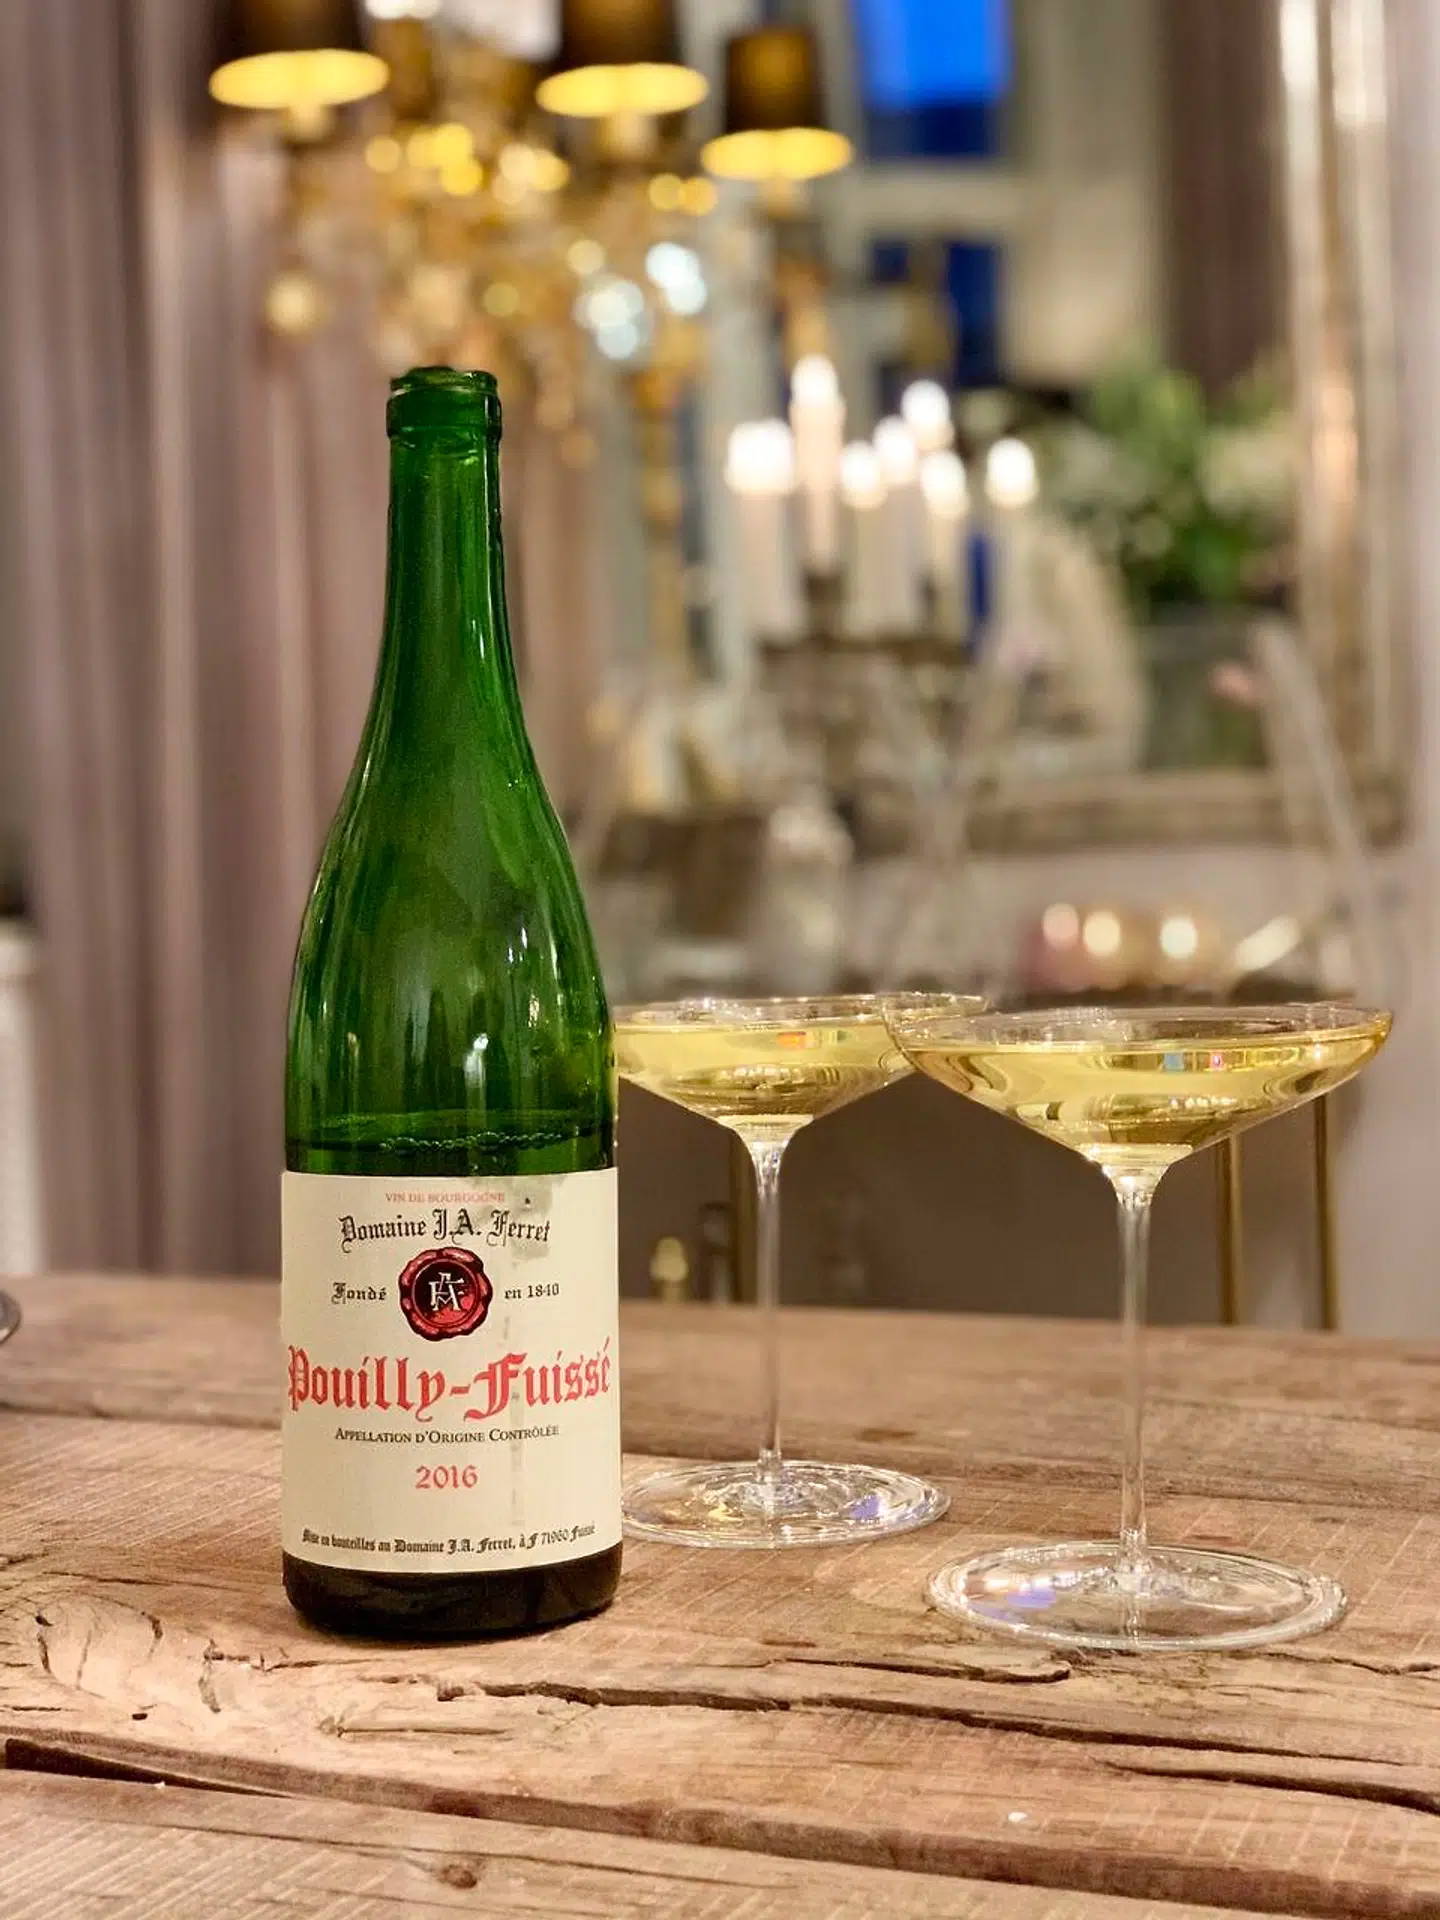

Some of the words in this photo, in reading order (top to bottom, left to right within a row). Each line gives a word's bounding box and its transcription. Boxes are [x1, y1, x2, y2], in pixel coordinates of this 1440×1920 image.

[385, 1192, 406, 1203] VIN
[409, 1192, 424, 1203] DE
[427, 1192, 505, 1203] BOURGOGNE
[337, 1213, 427, 1254] Domaine
[486, 1208, 551, 1247] Ferret
[331, 1281, 388, 1304] Fondé
[504, 1287, 522, 1300] en
[526, 1283, 560, 1299] 1840
[287, 1336, 613, 1423] Pouilly-Fuissé
[415, 1464, 479, 1489] 2016
[394, 1538, 445, 1553] Domaine
